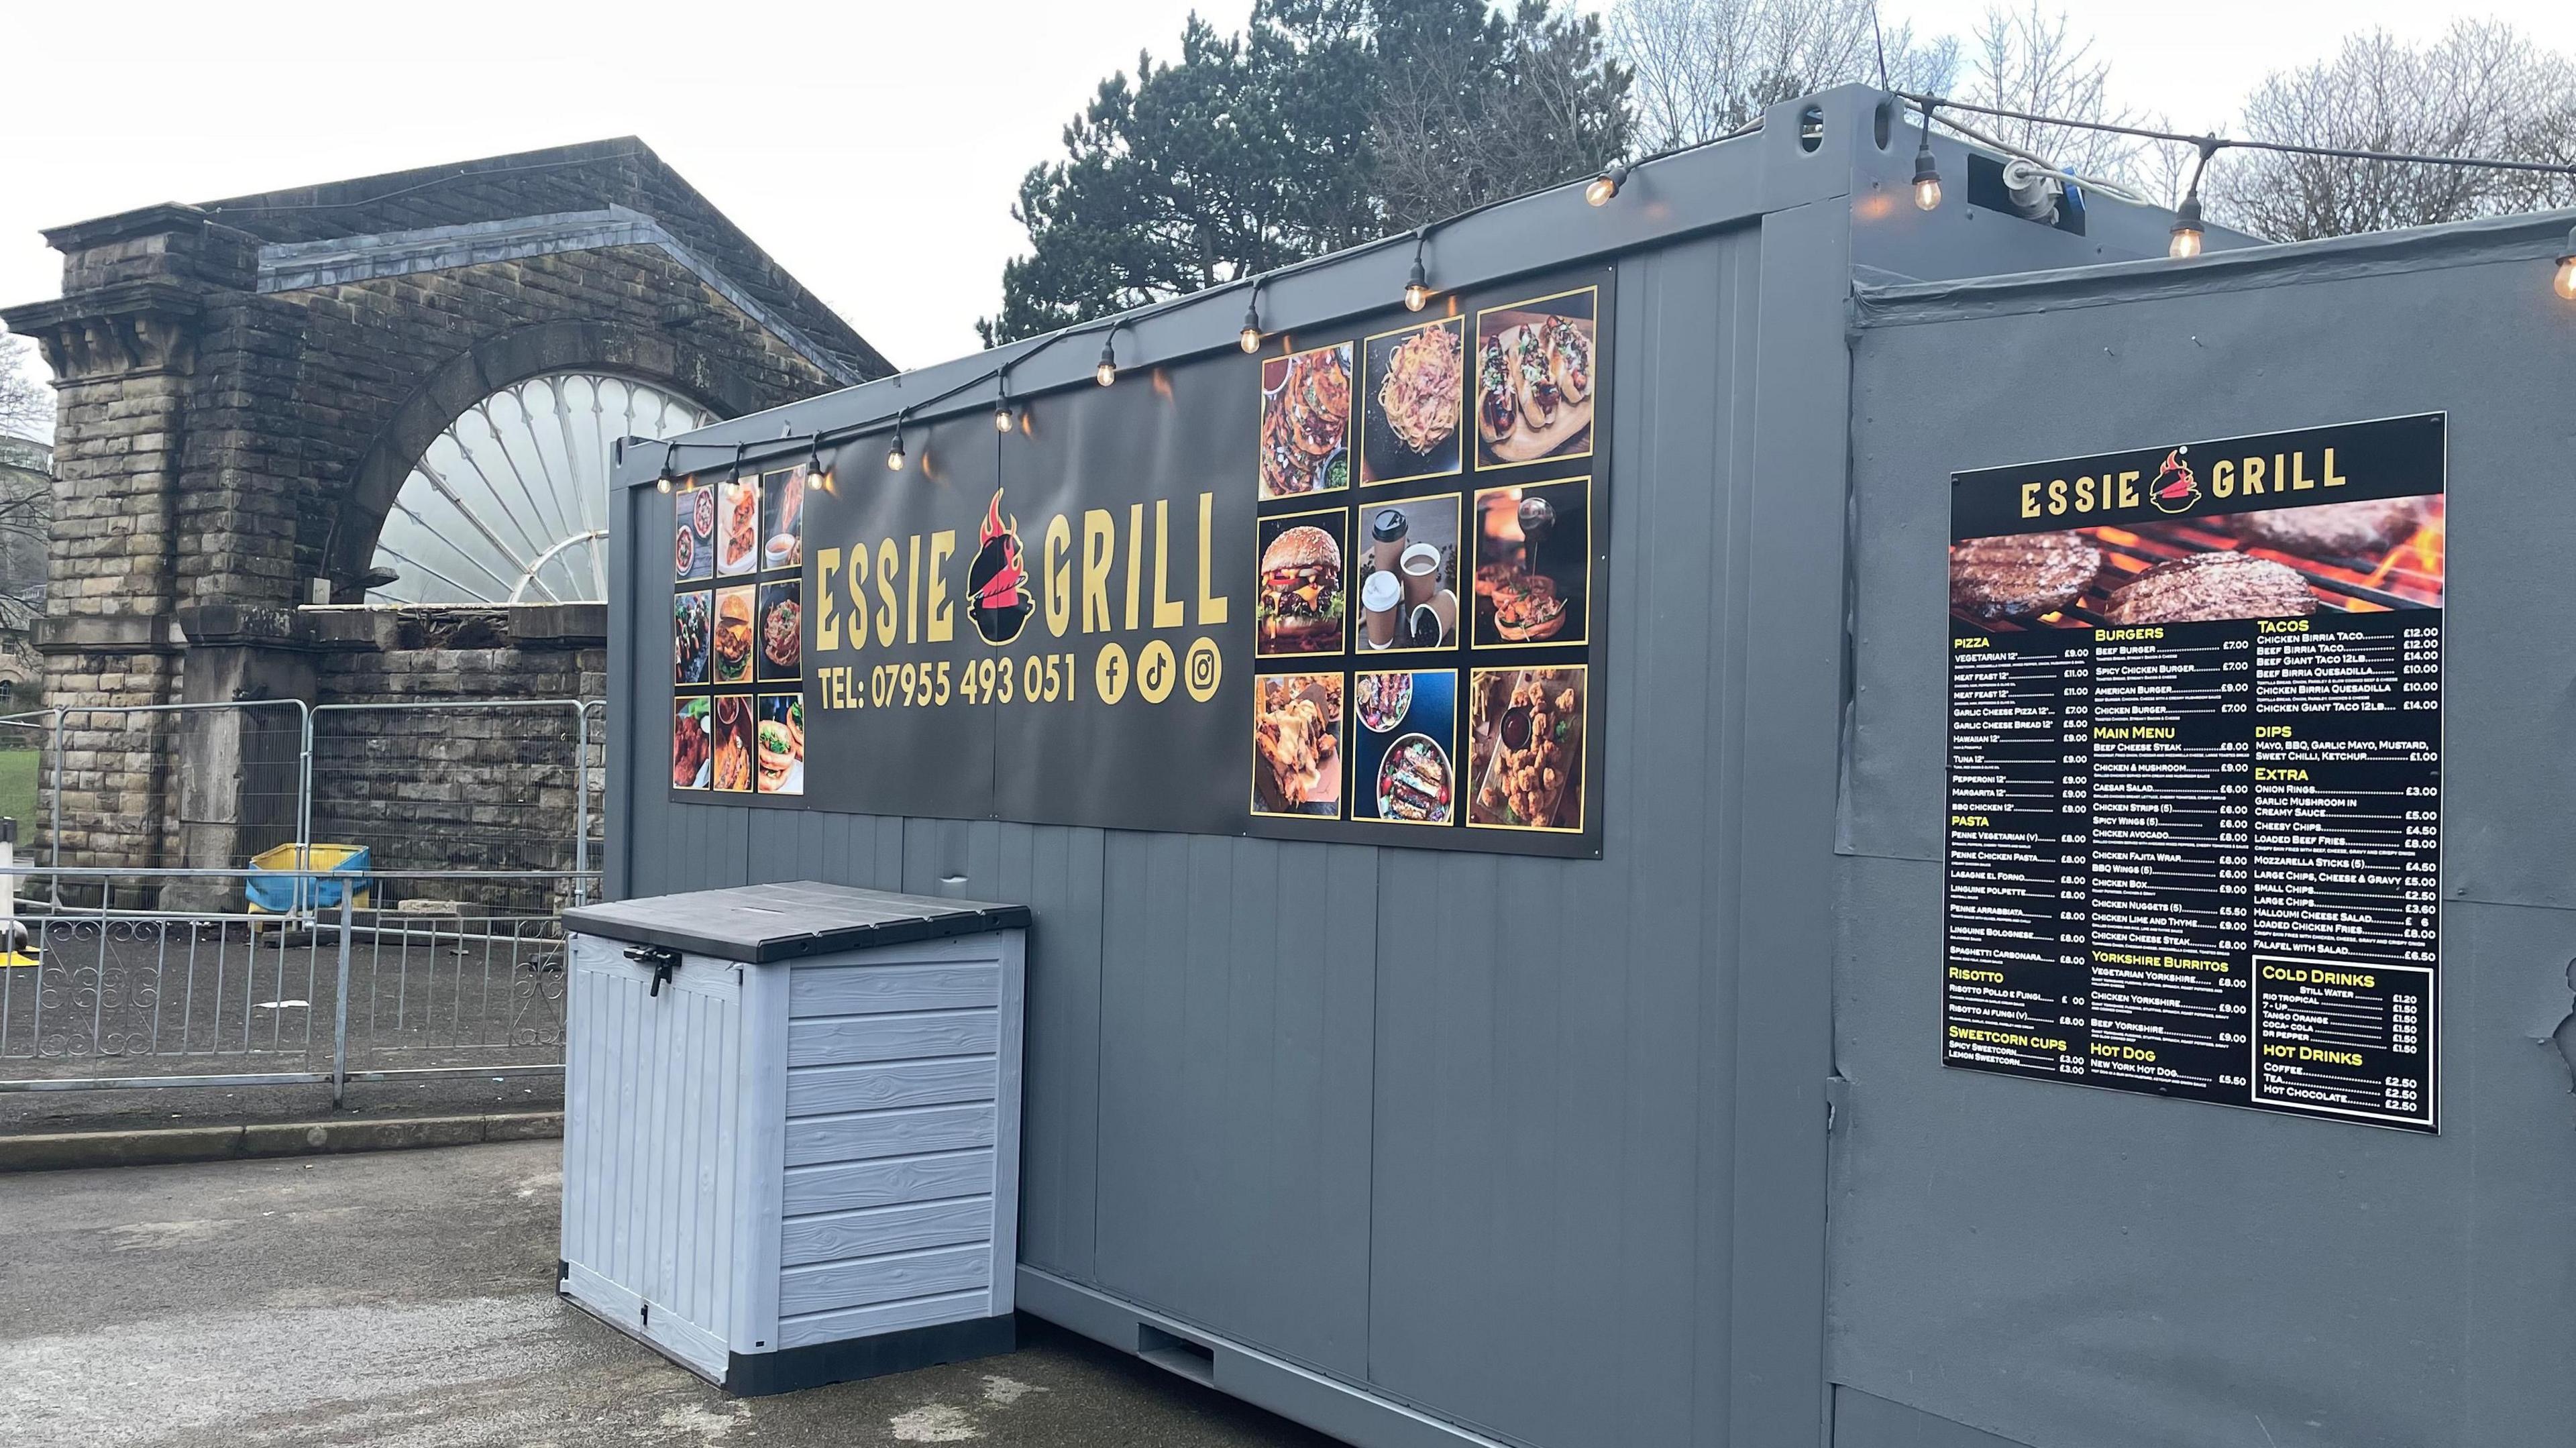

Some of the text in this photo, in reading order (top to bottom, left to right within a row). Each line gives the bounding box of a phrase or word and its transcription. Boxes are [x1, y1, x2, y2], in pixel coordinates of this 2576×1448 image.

[2021, 448, 2346, 518] ESSIE GRILL
[816, 492, 1228, 651] ESSIE GRILL
[2257, 620, 2309, 633] TACOS
[2095, 628, 2164, 641] BURGERS
[2257, 628, 2438, 644] CHICKEN BIRRIA £12.00
[1954, 638, 1990, 649] PIZZA
[2119, 647, 2155, 655] BURGER
[2223, 641, 2248, 649] £7.00
[2257, 640, 2438, 655] BEEF BIRRIA £12.00
[1955, 649, 2088, 662] VEGETARIAN £9.00
[2257, 651, 2438, 666] BEEF GIANT TACO £14.00
[2121, 666, 2157, 674] CHICKEN
[2223, 663, 2248, 671] £7.00
[2257, 665, 2438, 678] BEEF BIRRIA £10.00
[818, 653, 1075, 709] TEL: 07955 493 051
[2257, 683, 2438, 695] CHICKEN BIRRIA QUESADILLA £10.00
[2222, 705, 2247, 713] £7.00
[2256, 701, 2437, 712] CHICKEN GIANT TACO £14.00
[2094, 726, 2175, 738] MAIN MENU
[2255, 726, 2292, 738] DIPS
[2256, 752, 2286, 761] SWEET
[2410, 753, 2437, 761] £1.00
[2255, 768, 2308, 781] EXTRA
[2255, 785, 2437, 796] ONION £3.00
[2093, 803, 2129, 811] CHICKEN
[2220, 805, 2247, 814] £6.00
[2290, 798, 2345, 806] MUSHROOM
[1952, 816, 1989, 826] PASTA
[2255, 808, 2436, 820] CREAMY £5.00
[2255, 822, 2436, 835] CHEESY £4.50
[1951, 831, 1977, 839] PENNE
[1978, 832, 2025, 841] VEGETARIAN
[2255, 835, 2436, 848] LOADED BEEF £8.00
[2254, 856, 2436, 871] MOZZARELLA STICKS £4.50
[2254, 871, 2284, 880] LARGE
[2318, 873, 2357, 882] CHEESE
[2367, 875, 2401, 885] GRAVY
[2405, 878, 2436, 887] £5.00
[2254, 885, 2284, 893] SMALL
[2254, 896, 2436, 913] LARGE £3.60
[2254, 908, 2339, 920] HALLOUMI CHEESE
[2254, 920, 2436, 938] LOADED CHICKEN £8.00
[2253, 940, 2316, 952] FALAFEL WITH
[2092, 951, 2229, 972] YORKSHIRE BURRITOS
[1949, 967, 2004, 983] RISOTTO
[2092, 967, 2144, 979] VEGETARIAN
[2219, 979, 2247, 988] £8.00
[2263, 966, 2375, 987] COLD DRINKS
[2092, 991, 2129, 1002] CHICKEN
[2219, 1004, 2246, 1013] £9.00
[2300, 987, 2417, 1003] STILL WATER £1.20
[2278, 995, 2319, 1004] TROPICAL
[2393, 1005, 2417, 1013] £1.50
[2263, 1011, 2417, 1034] TANGO ORANGE £1.50
[1949, 1025, 2067, 1052] SWEETCORN CUPS
[2291, 1023, 2313, 1032] COLA
[2393, 1034, 2417, 1043] £1.50
[2276, 1032, 2309, 1041] PEPPER
[2393, 1045, 2417, 1054] £1.50
[1949, 1040, 2084, 1065] SPICY £3.00
[2090, 1043, 2155, 1062] HOT DOG
[2263, 1045, 2363, 1066] HOT DRINKS
[1949, 1050, 2084, 1074] LEMON £3.00
[2091, 1059, 2246, 1086] NEW YORK HOT £5.50
[2385, 1077, 2417, 1088] £2.50
[2264, 1084, 2417, 1111] HOT £2.50
[2385, 1089, 2417, 1099] £2.50
